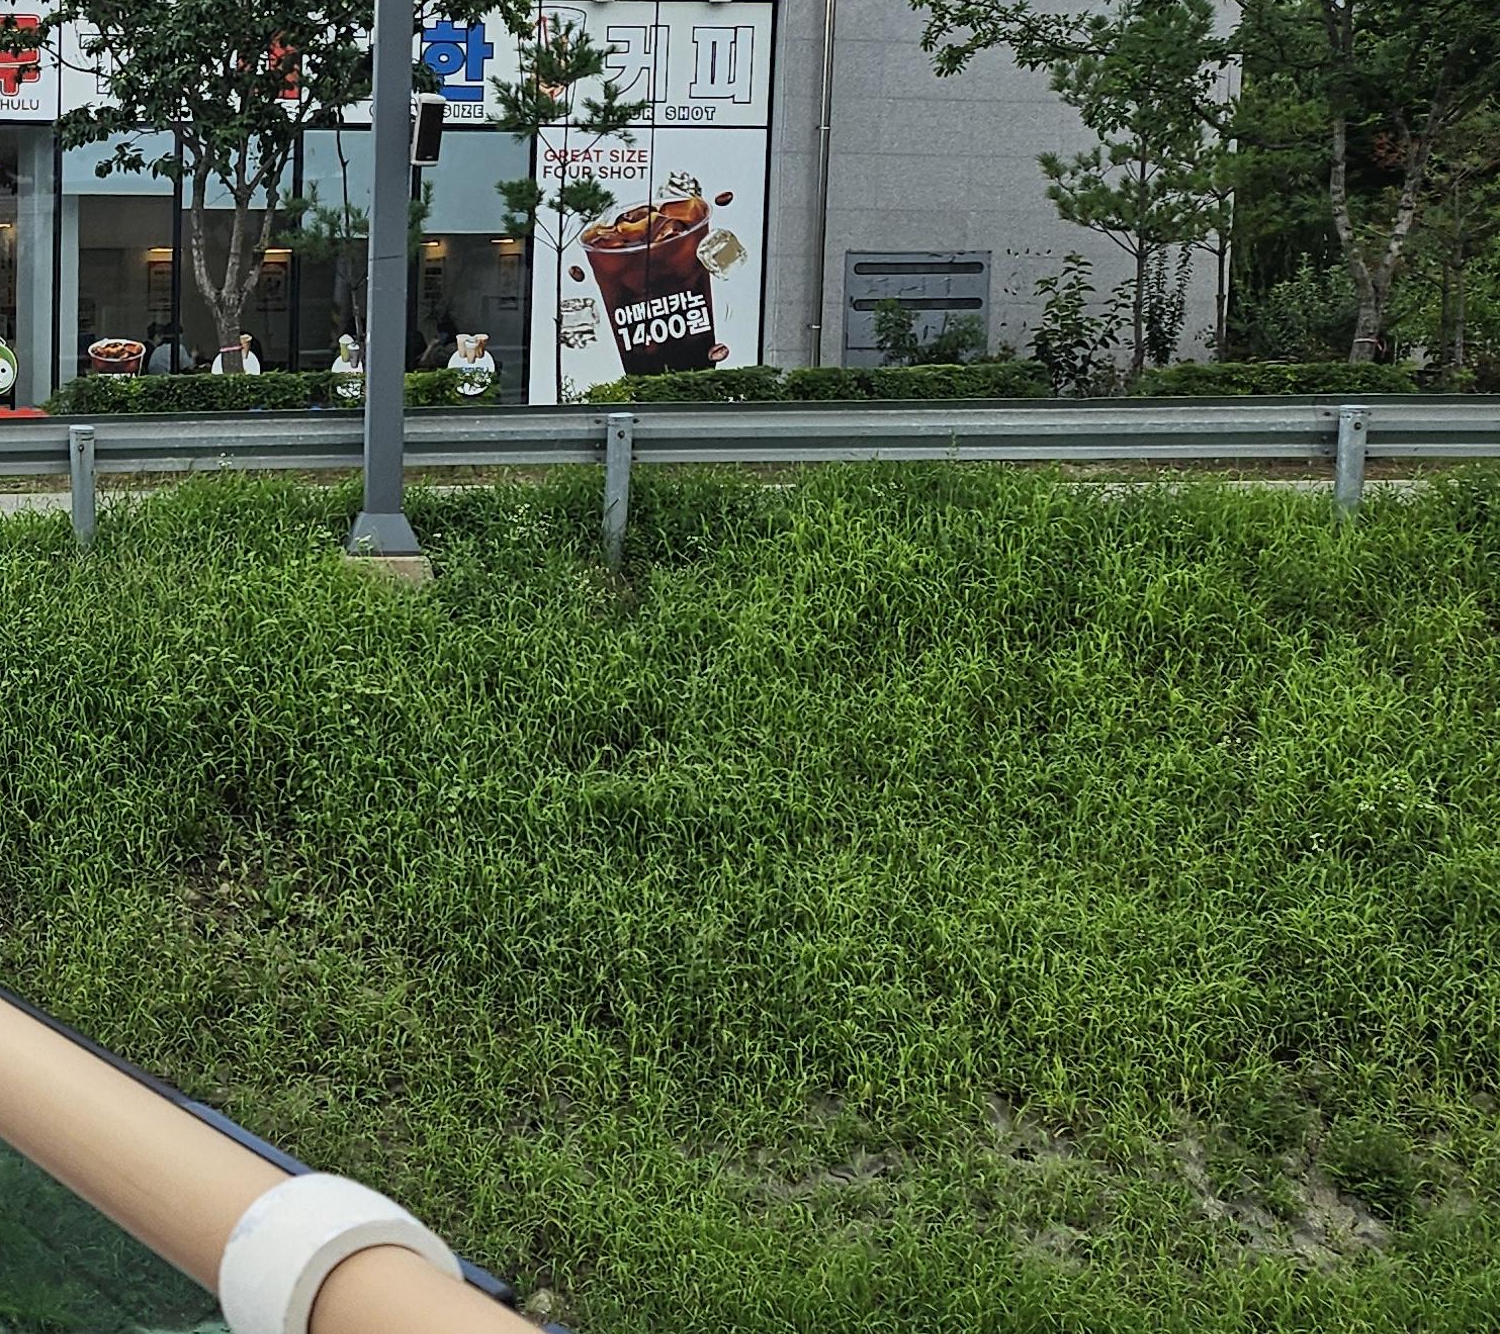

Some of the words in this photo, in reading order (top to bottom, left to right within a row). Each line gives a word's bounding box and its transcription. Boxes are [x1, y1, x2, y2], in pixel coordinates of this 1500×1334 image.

[604, 25, 754, 104] 커피
[442, 104, 484, 118] SIZE
[665, 107, 716, 121] SHOT
[544, 149, 603, 163] GREAT
[609, 149, 648, 163] SIZE
[543, 166, 594, 179] FOUR
[598, 166, 648, 179] SHOT
[614, 291, 706, 325] 아메리카노
